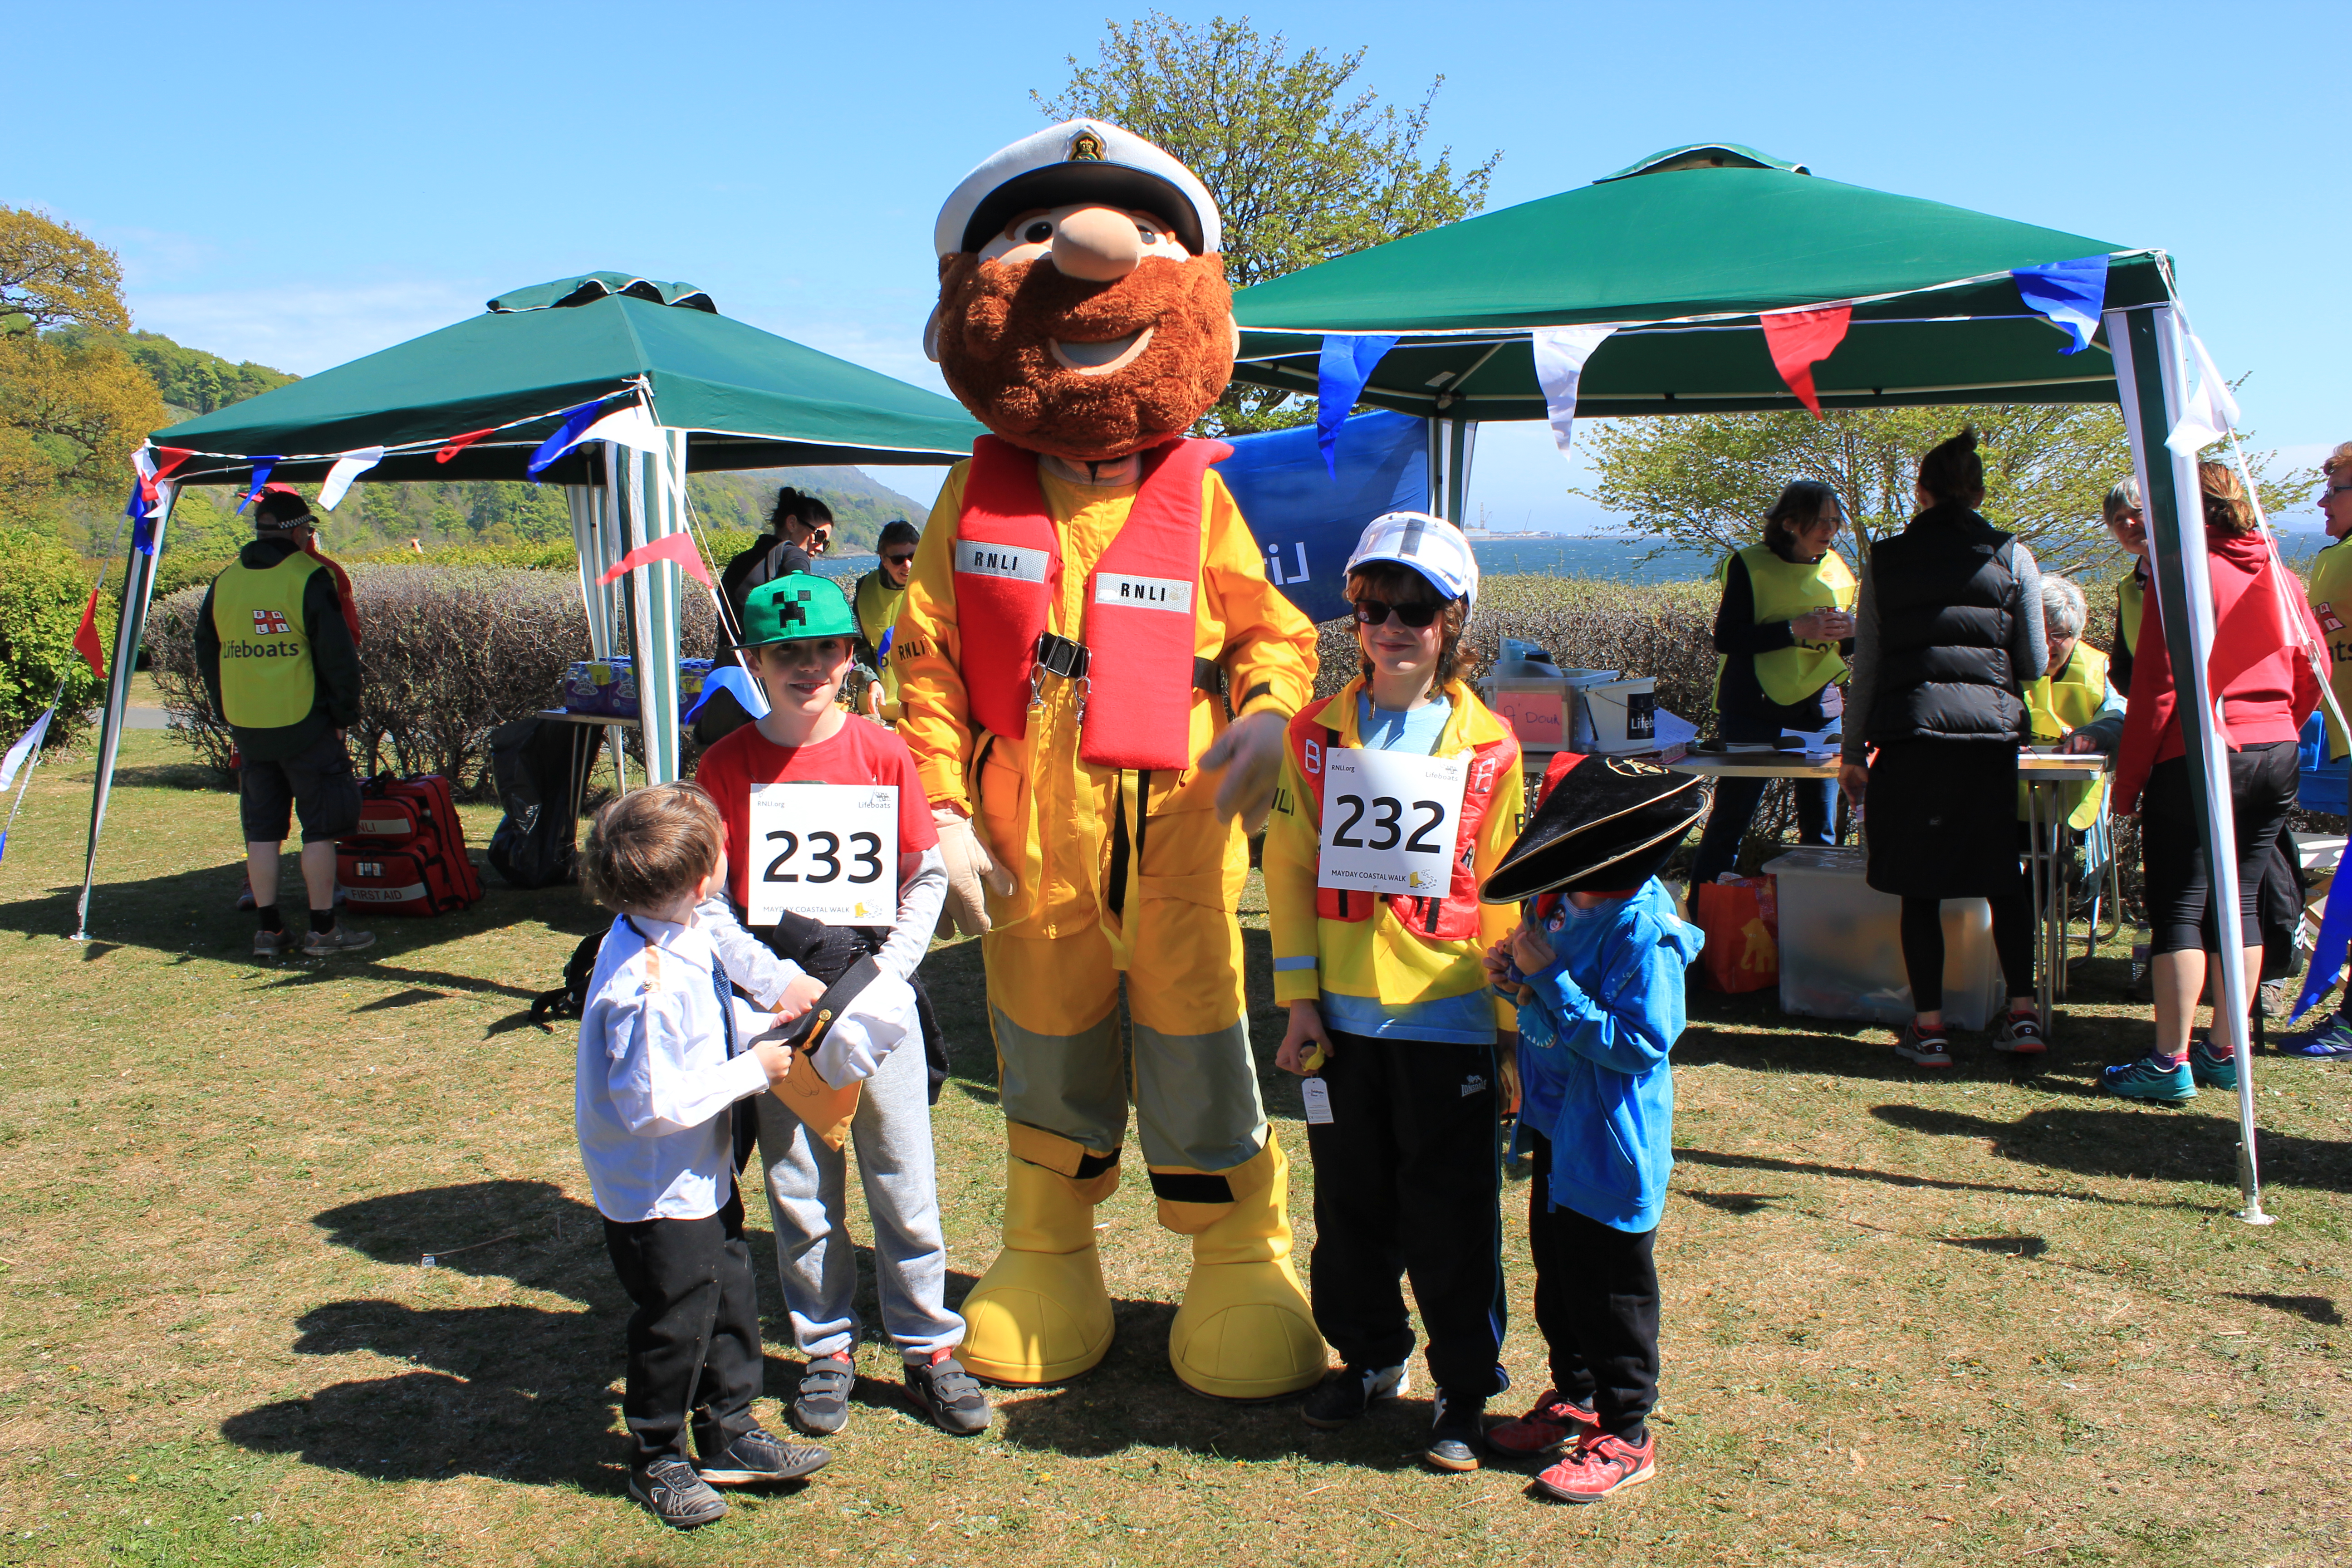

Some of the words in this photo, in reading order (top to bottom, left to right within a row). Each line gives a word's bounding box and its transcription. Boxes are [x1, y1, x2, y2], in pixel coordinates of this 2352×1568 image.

[974, 551, 1018, 571] RNLI
[1121, 583, 1165, 602] RNLI
[223, 639, 299, 659] Lifeboats
[898, 640, 926, 661] RNLI
[1631, 716, 1655, 729] Lifeb
[1331, 764, 1355, 773] RNLI.org
[1425, 771, 1458, 782] Lifeboats
[1332, 794, 1445, 853] 232
[763, 830, 883, 884] 233
[1331, 870, 1358, 878] MAYDAY
[1359, 872, 1387, 880] COASTAL
[351, 889, 380, 900] FIRST
[384, 890, 402, 900] AID
